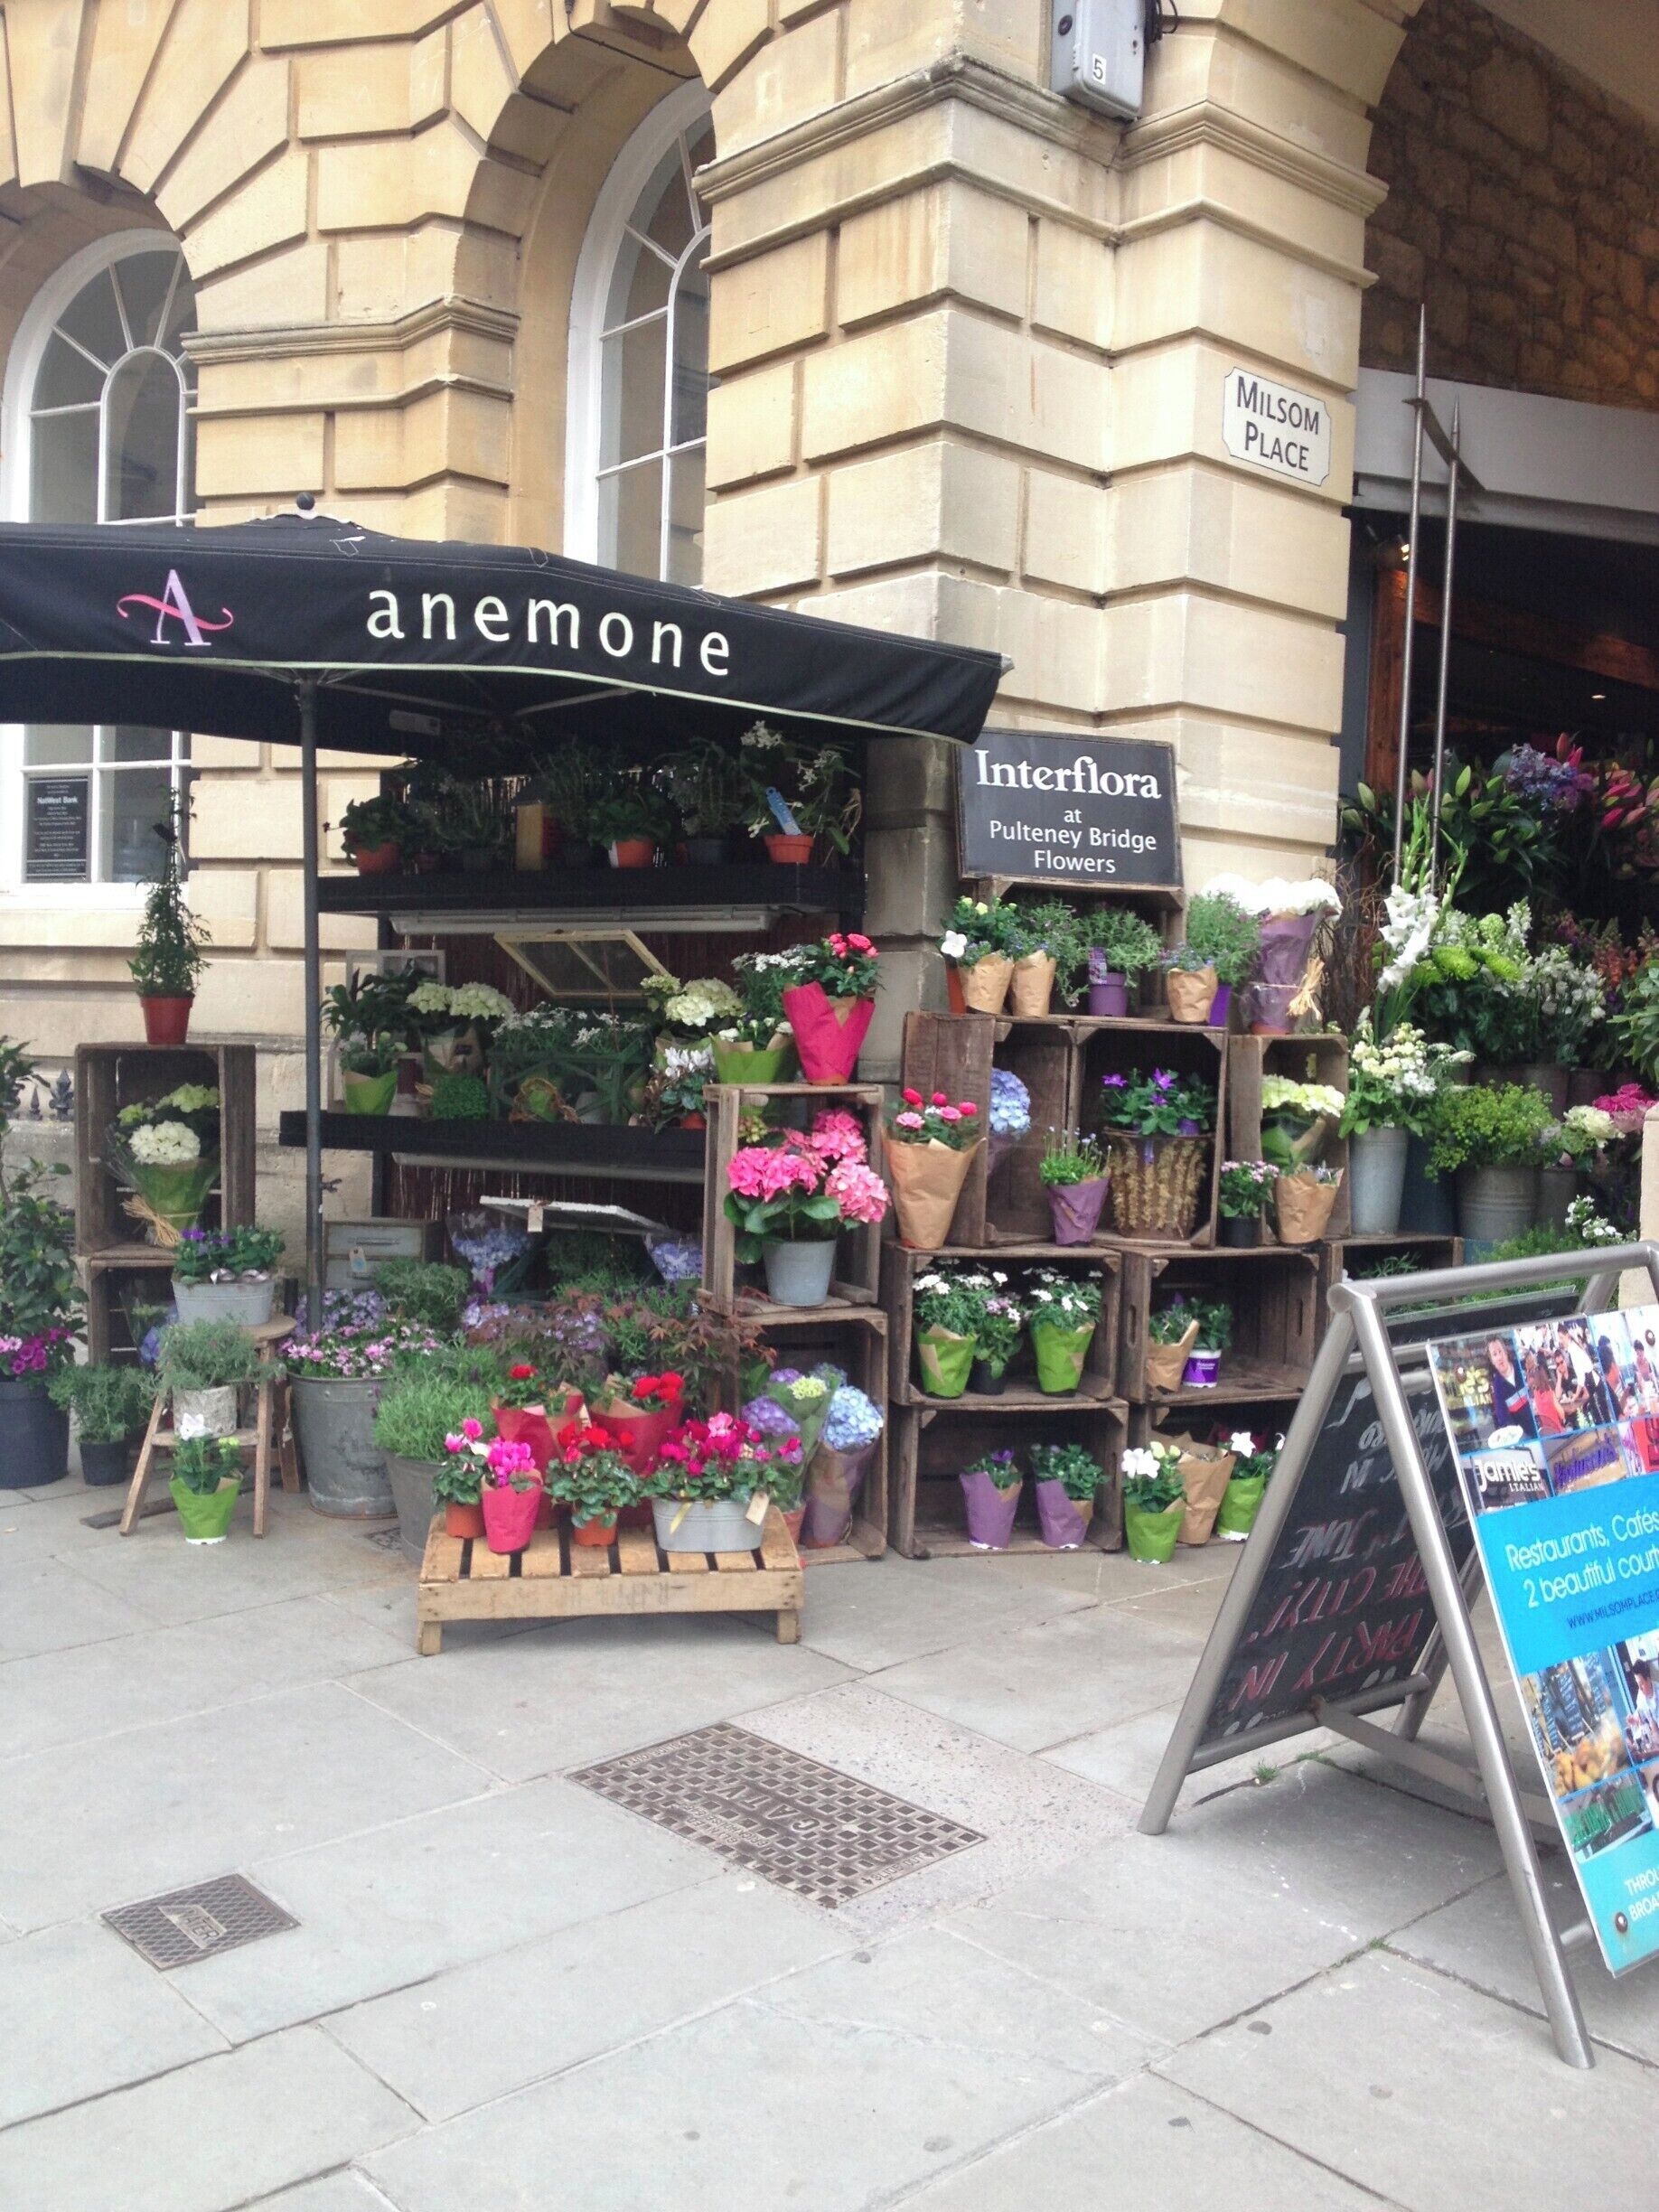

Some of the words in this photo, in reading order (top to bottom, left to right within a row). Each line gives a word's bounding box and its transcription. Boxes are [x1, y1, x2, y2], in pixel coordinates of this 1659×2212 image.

[1092, 58, 1104, 80] 5
[1237, 375, 1319, 435] MILSOM
[1244, 420, 1309, 472] PLACE
[367, 588, 730, 676] anemone
[974, 749, 1162, 799] Interflora
[37, 796, 61, 804] NatWest
[62, 795, 79, 803] Bank
[1064, 809, 1083, 823] at
[989, 820, 1083, 848] Pulteney
[1090, 827, 1157, 853] Bridge
[1034, 849, 1116, 873] Flowers
[1504, 1522, 1609, 1572] Restaurants,
[1523, 1579, 1539, 1608] 2
[1539, 1556, 1616, 1602] beautiful
[717, 1785, 820, 1832] CATV
